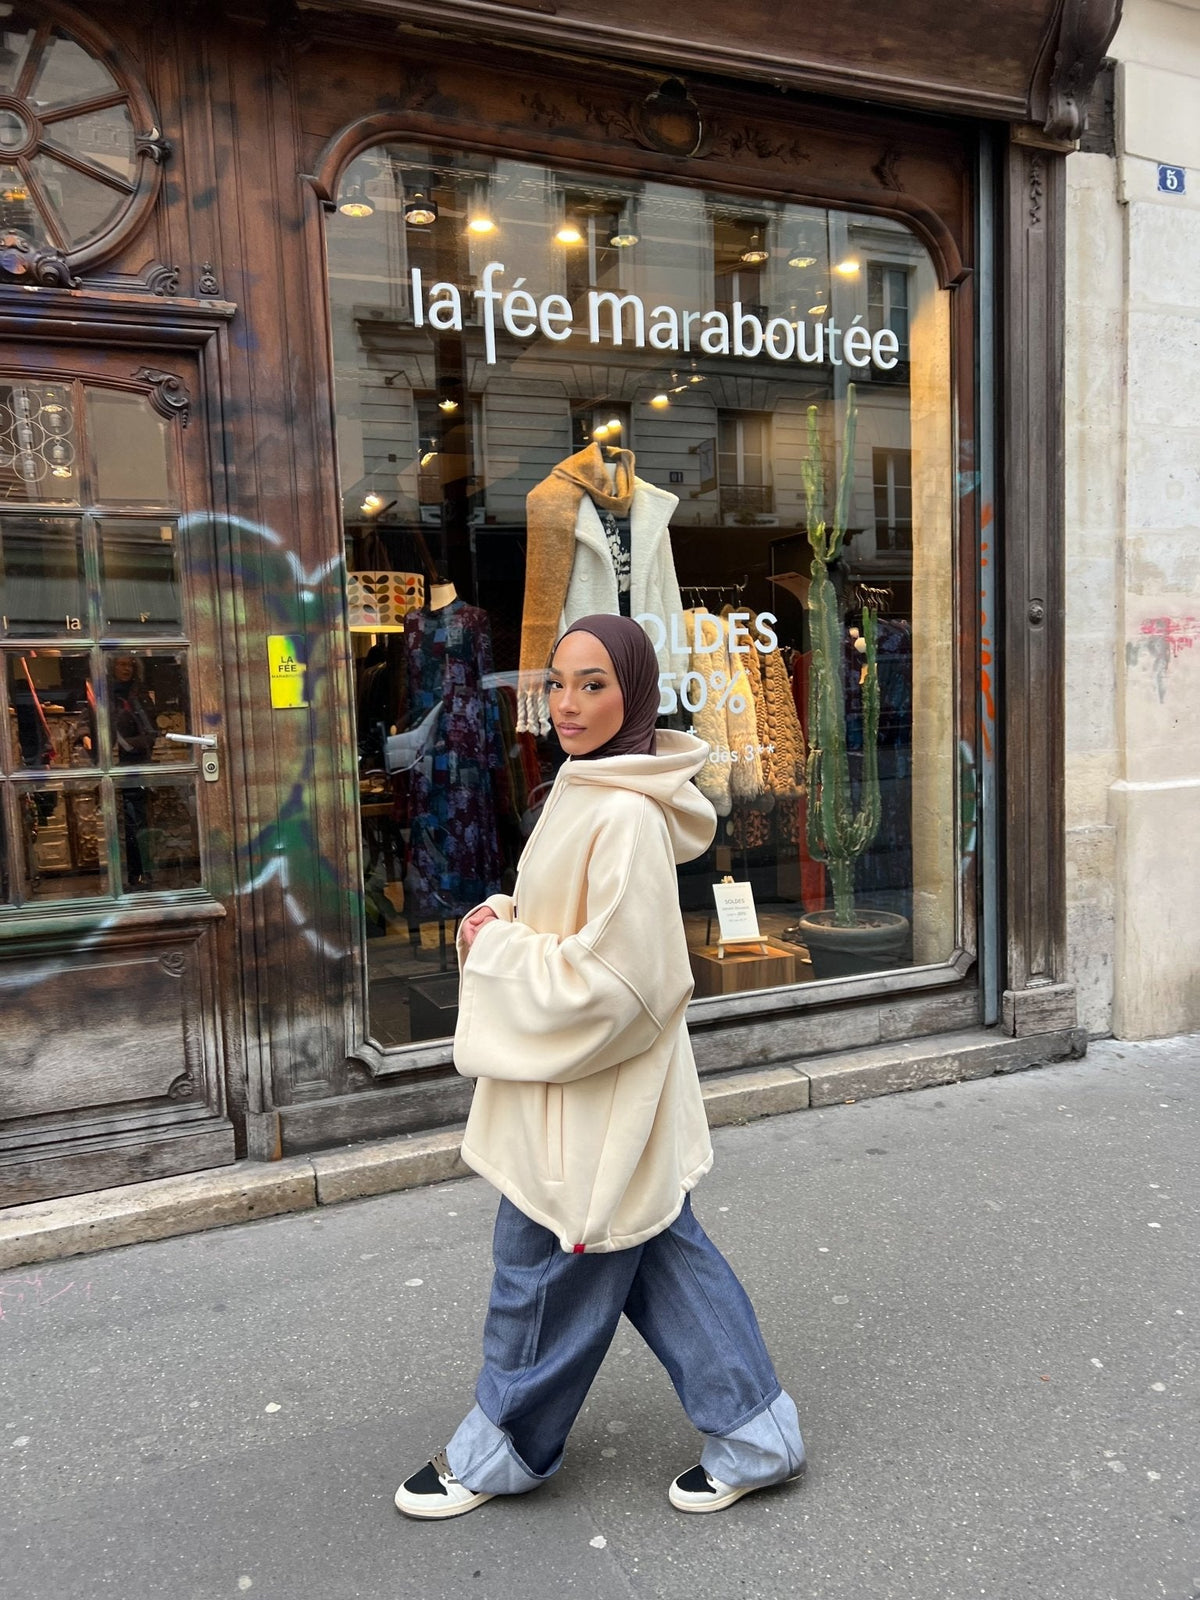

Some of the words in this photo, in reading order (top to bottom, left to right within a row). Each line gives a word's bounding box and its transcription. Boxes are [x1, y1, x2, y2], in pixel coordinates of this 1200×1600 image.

[1166, 169, 1178, 190] 5
[411, 267, 462, 331] la
[474, 262, 574, 365] fée
[588, 290, 899, 370] maraboutée
[634, 612, 779, 653] OLDES
[281, 655, 294, 663] LA
